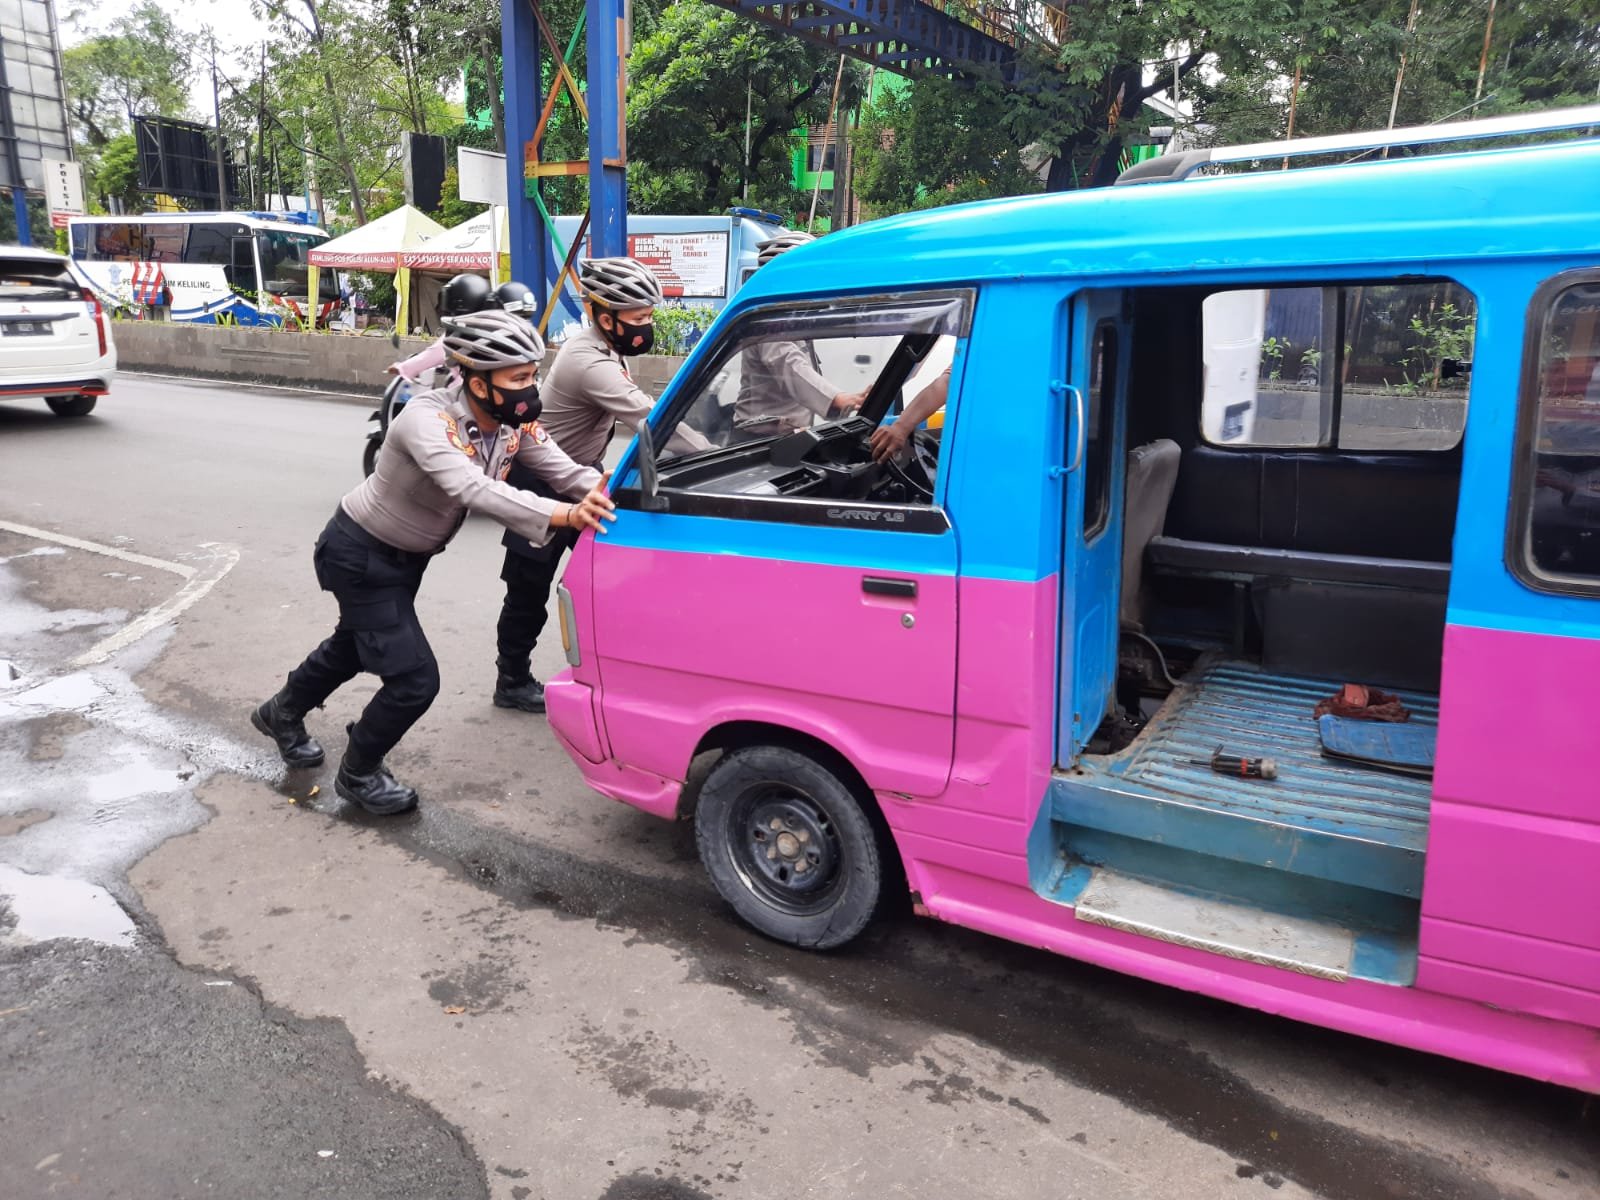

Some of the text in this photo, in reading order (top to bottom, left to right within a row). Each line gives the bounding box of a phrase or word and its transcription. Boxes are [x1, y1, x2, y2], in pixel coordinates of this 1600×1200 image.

[59, 163, 69, 206] POLISI
[446, 255, 475, 264] SERANG
[477, 256, 493, 264] KOT
[177, 280, 211, 289] KELILING
[826, 508, 882, 521] CARRY
